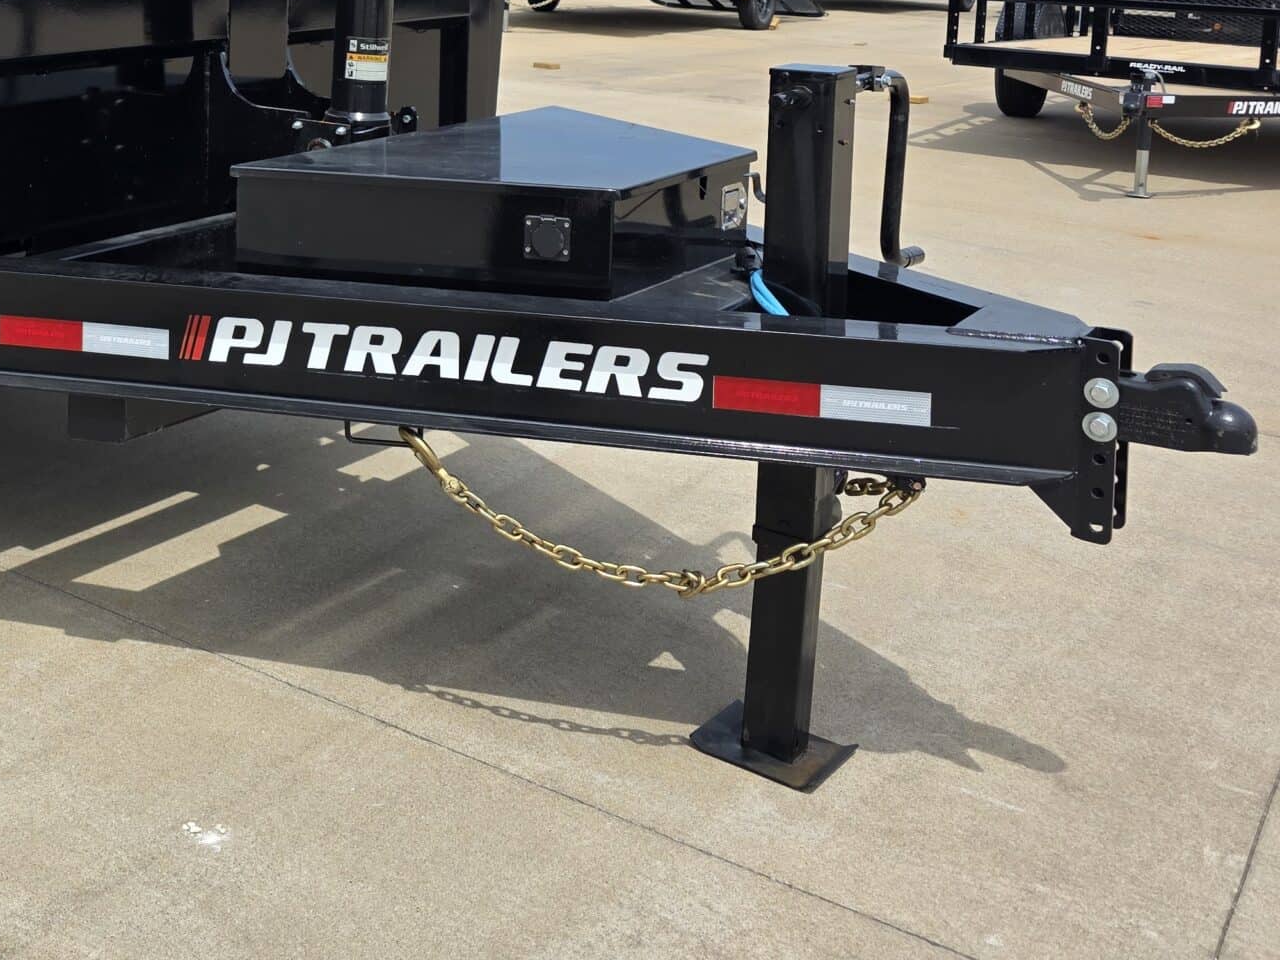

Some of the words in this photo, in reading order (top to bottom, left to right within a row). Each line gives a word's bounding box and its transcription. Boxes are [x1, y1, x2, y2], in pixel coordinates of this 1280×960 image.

[1232, 101, 1248, 114] PJ
[208, 316, 293, 366] PJ
[301, 321, 710, 403] TRAILERS
